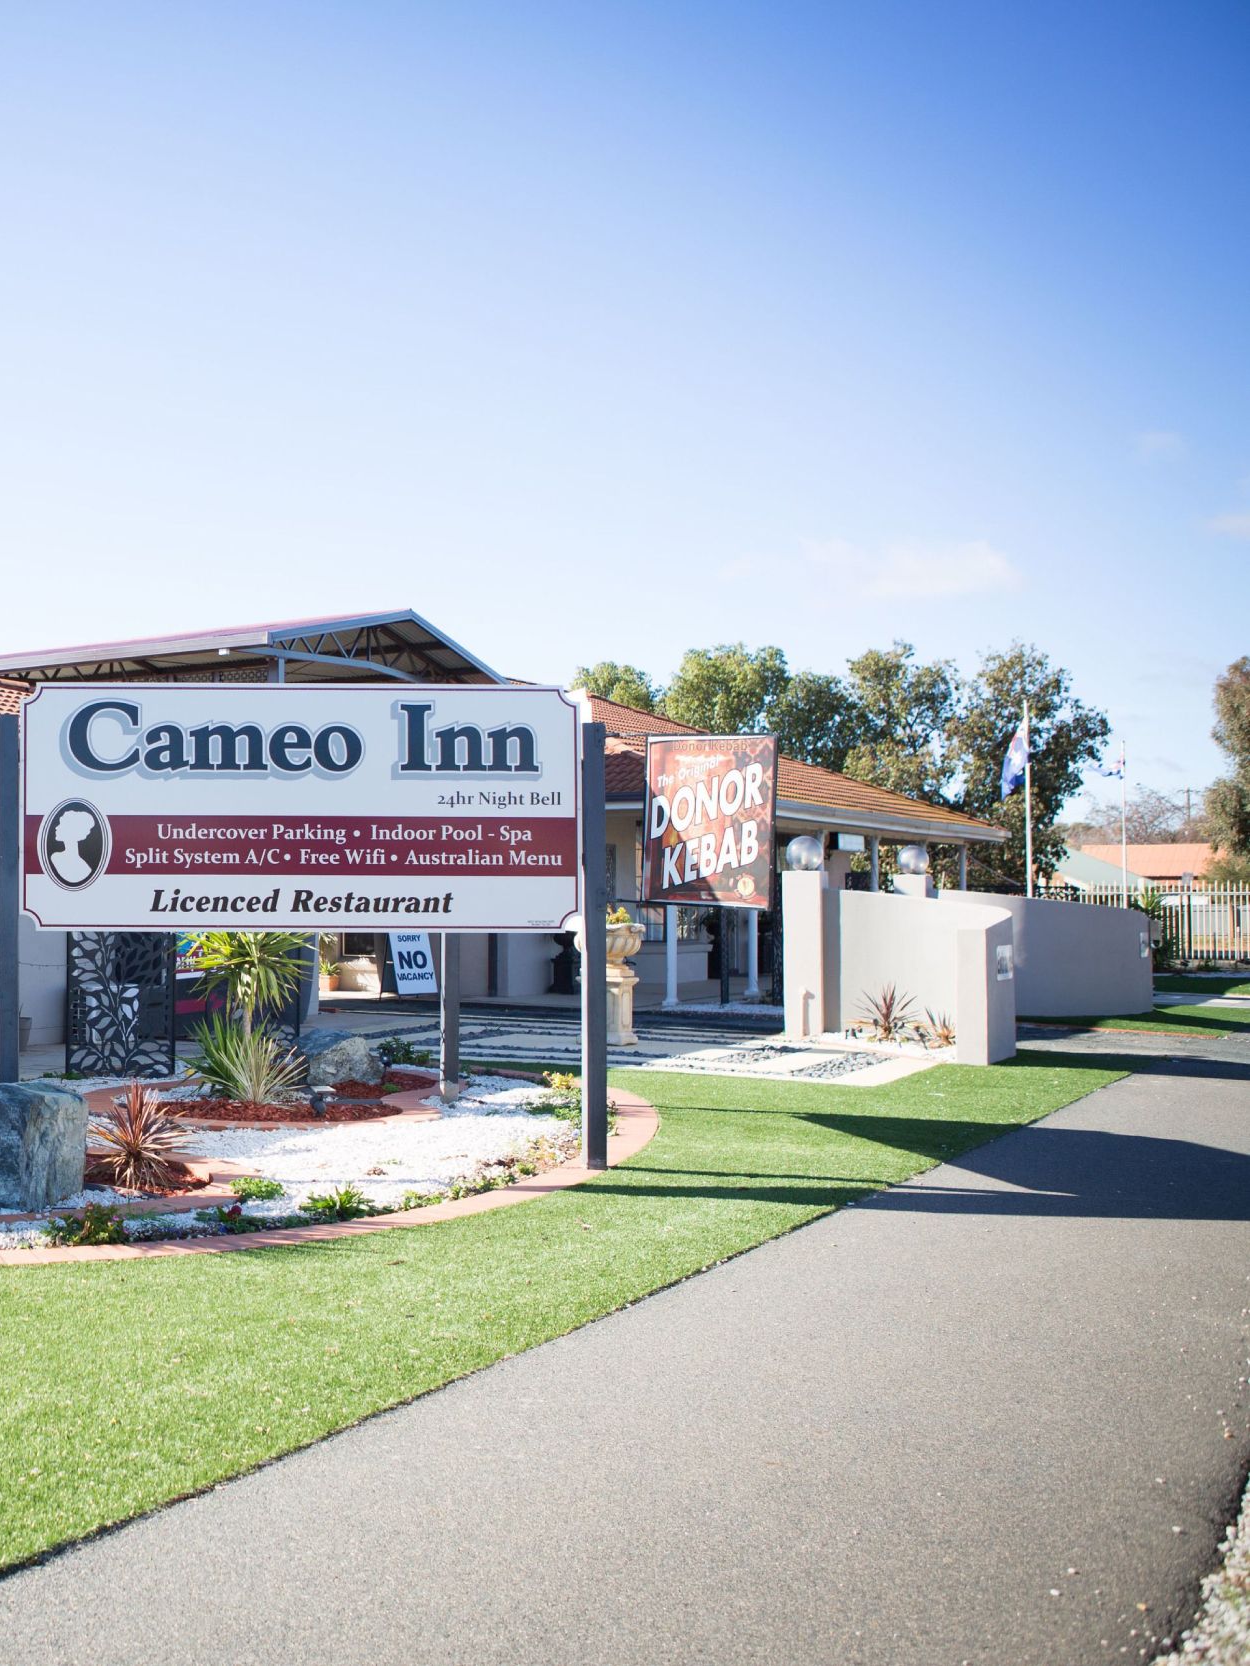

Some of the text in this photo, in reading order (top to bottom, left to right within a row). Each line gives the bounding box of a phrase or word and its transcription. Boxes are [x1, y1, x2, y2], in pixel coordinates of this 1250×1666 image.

[66, 700, 541, 774] Cameo Inn
[673, 741, 748, 751] Donor Kebab
[657, 758, 718, 788] The Original
[437, 790, 562, 809] 24hr Night Bell
[650, 762, 764, 839] DONOR
[157, 822, 268, 841] Undercover
[272, 823, 347, 845] Parking
[370, 823, 438, 842] Indoor
[441, 824, 483, 842] Pool
[499, 825, 533, 846] Spa
[125, 847, 563, 869] Split System A/C Free Wifi Australian Menu
[662, 819, 759, 890] KEBAB
[149, 888, 454, 915] Licenced Restaurant
[397, 934, 421, 942] SORRY
[397, 950, 428, 970] NO
[397, 971, 434, 981] VACANCY
